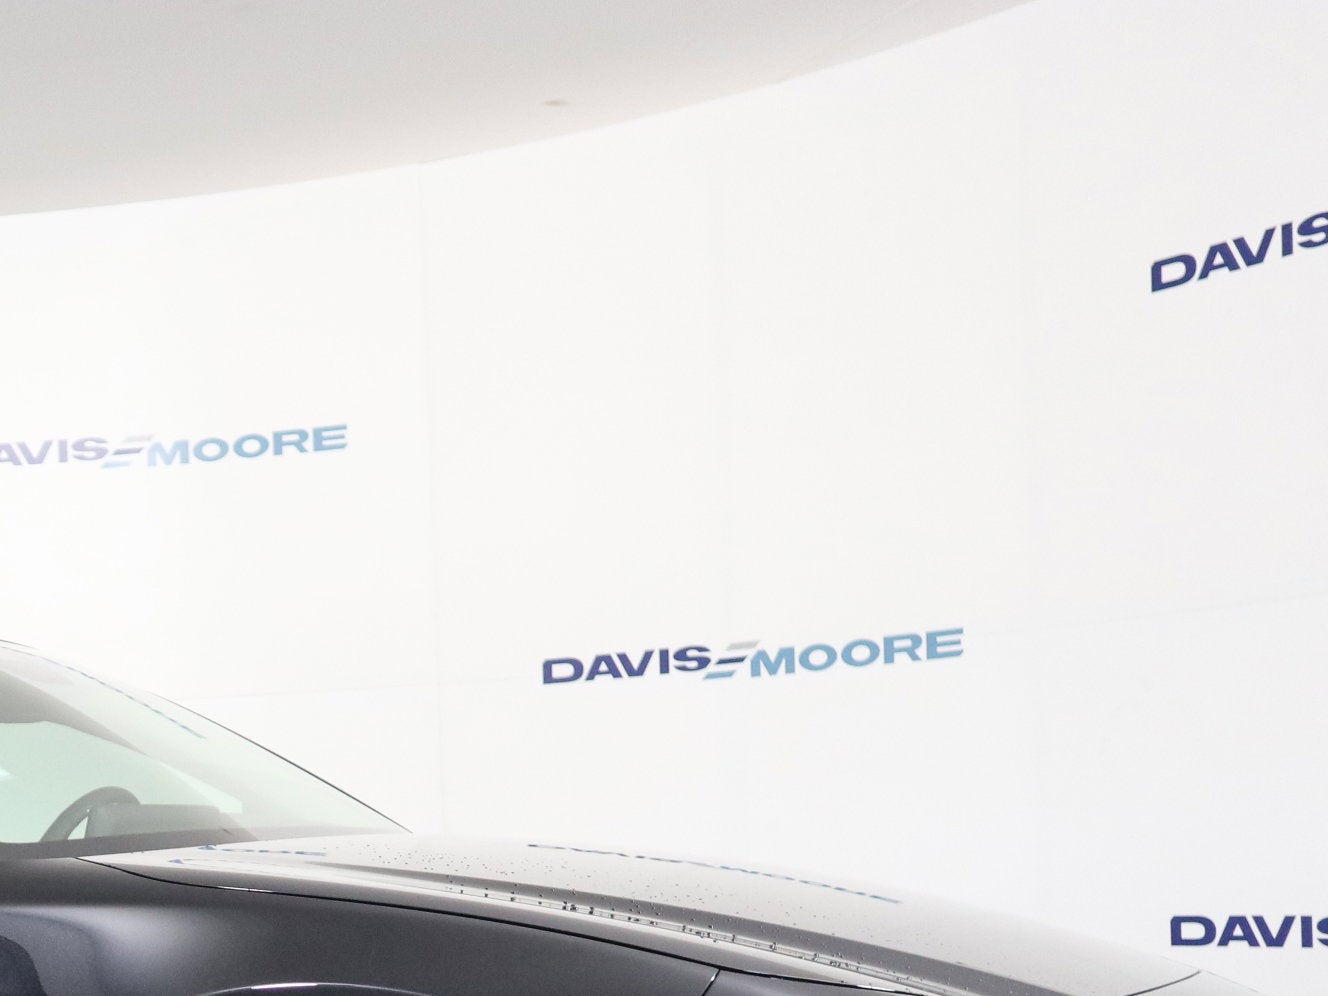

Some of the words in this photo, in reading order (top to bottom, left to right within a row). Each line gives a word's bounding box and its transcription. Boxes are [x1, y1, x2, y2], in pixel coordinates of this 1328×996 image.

[147, 424, 348, 466] MOORE
[542, 645, 712, 684] DAVIS
[750, 627, 964, 678] MOORE
